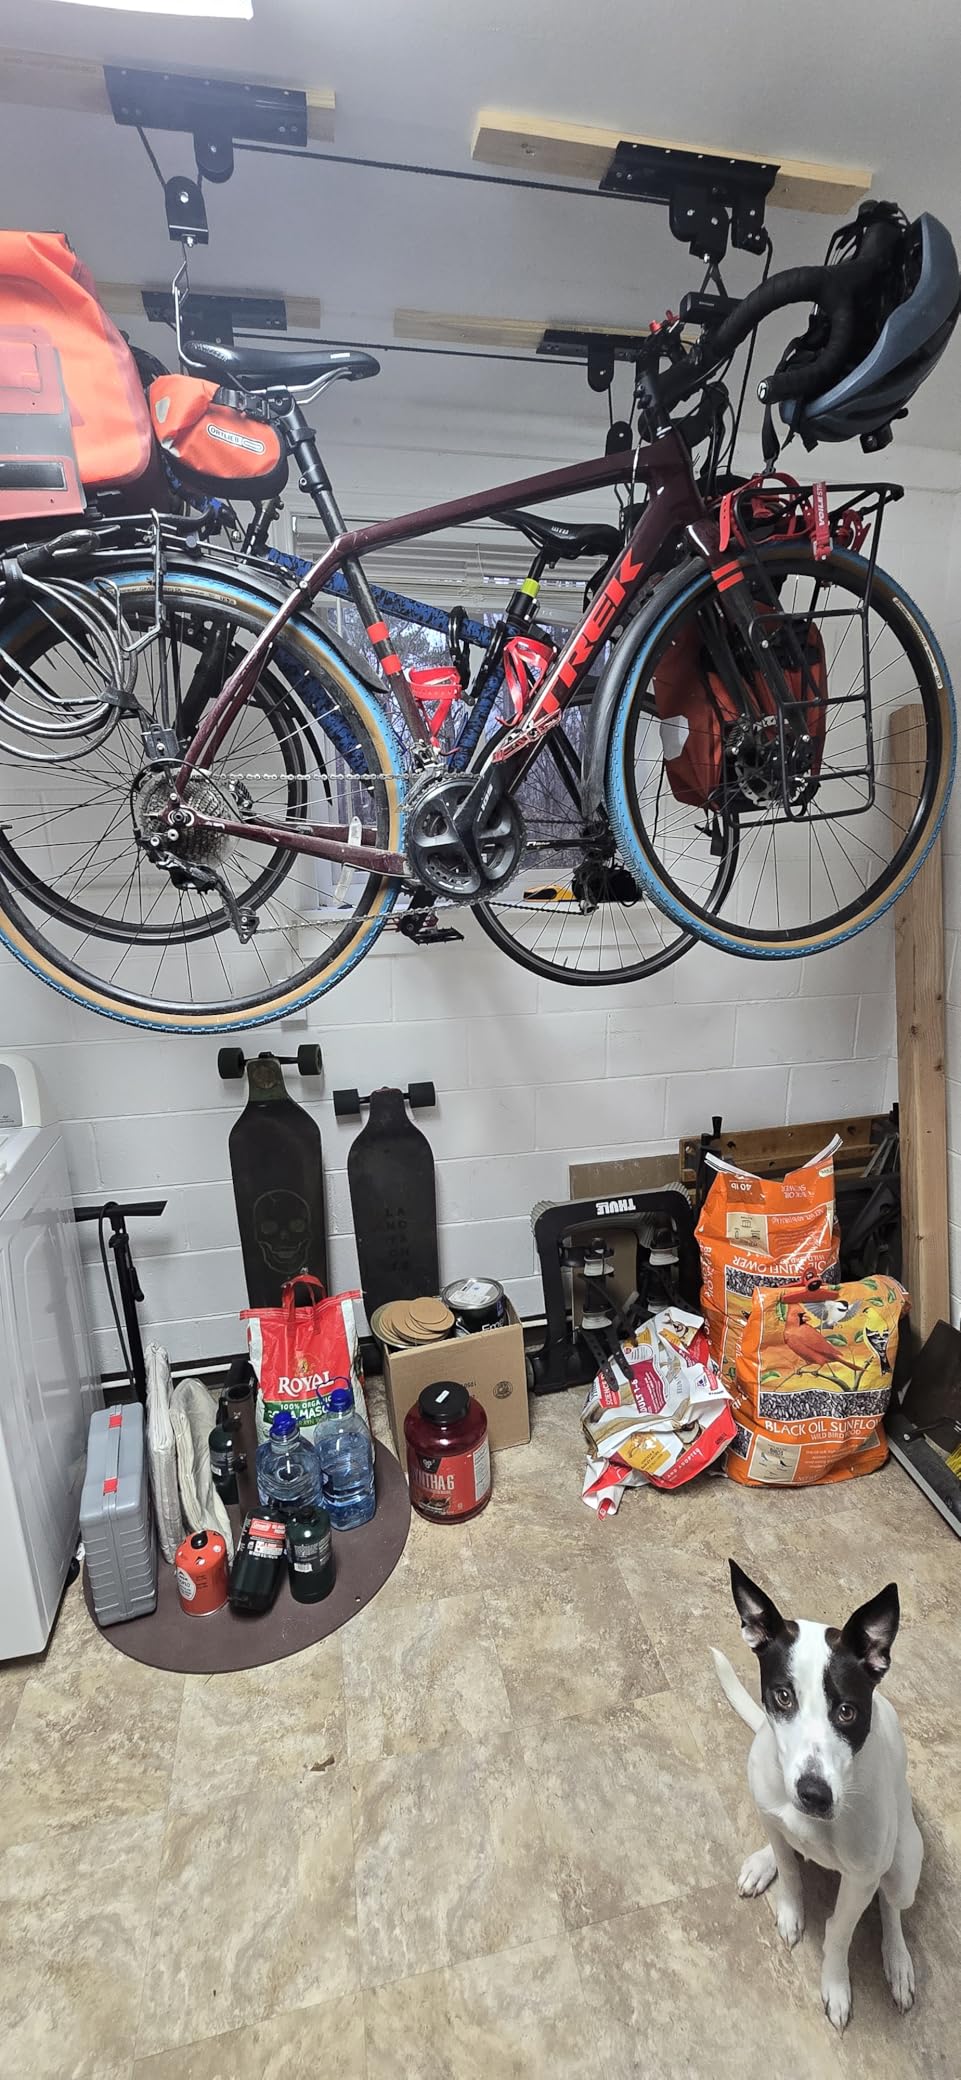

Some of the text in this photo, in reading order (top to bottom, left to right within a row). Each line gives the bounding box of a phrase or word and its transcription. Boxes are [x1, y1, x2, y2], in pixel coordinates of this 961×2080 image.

[210, 427, 239, 443] ORTLIEB
[817, 496, 825, 527] VOILE
[533, 548, 643, 720] TREK
[596, 1198, 636, 1216] THULE
[277, 1371, 334, 1397] ROYAL
[631, 1379, 640, 1393] 1-6
[280, 1395, 332, 1411] 100% ORGAIC
[635, 1394, 648, 1414] DULT
[765, 1420, 805, 1436] BLACK
[808, 1421, 828, 1435] OIL
[811, 1432, 827, 1440] WILD
[827, 1431, 844, 1440] BIRD
[447, 1474, 455, 1490] 6
